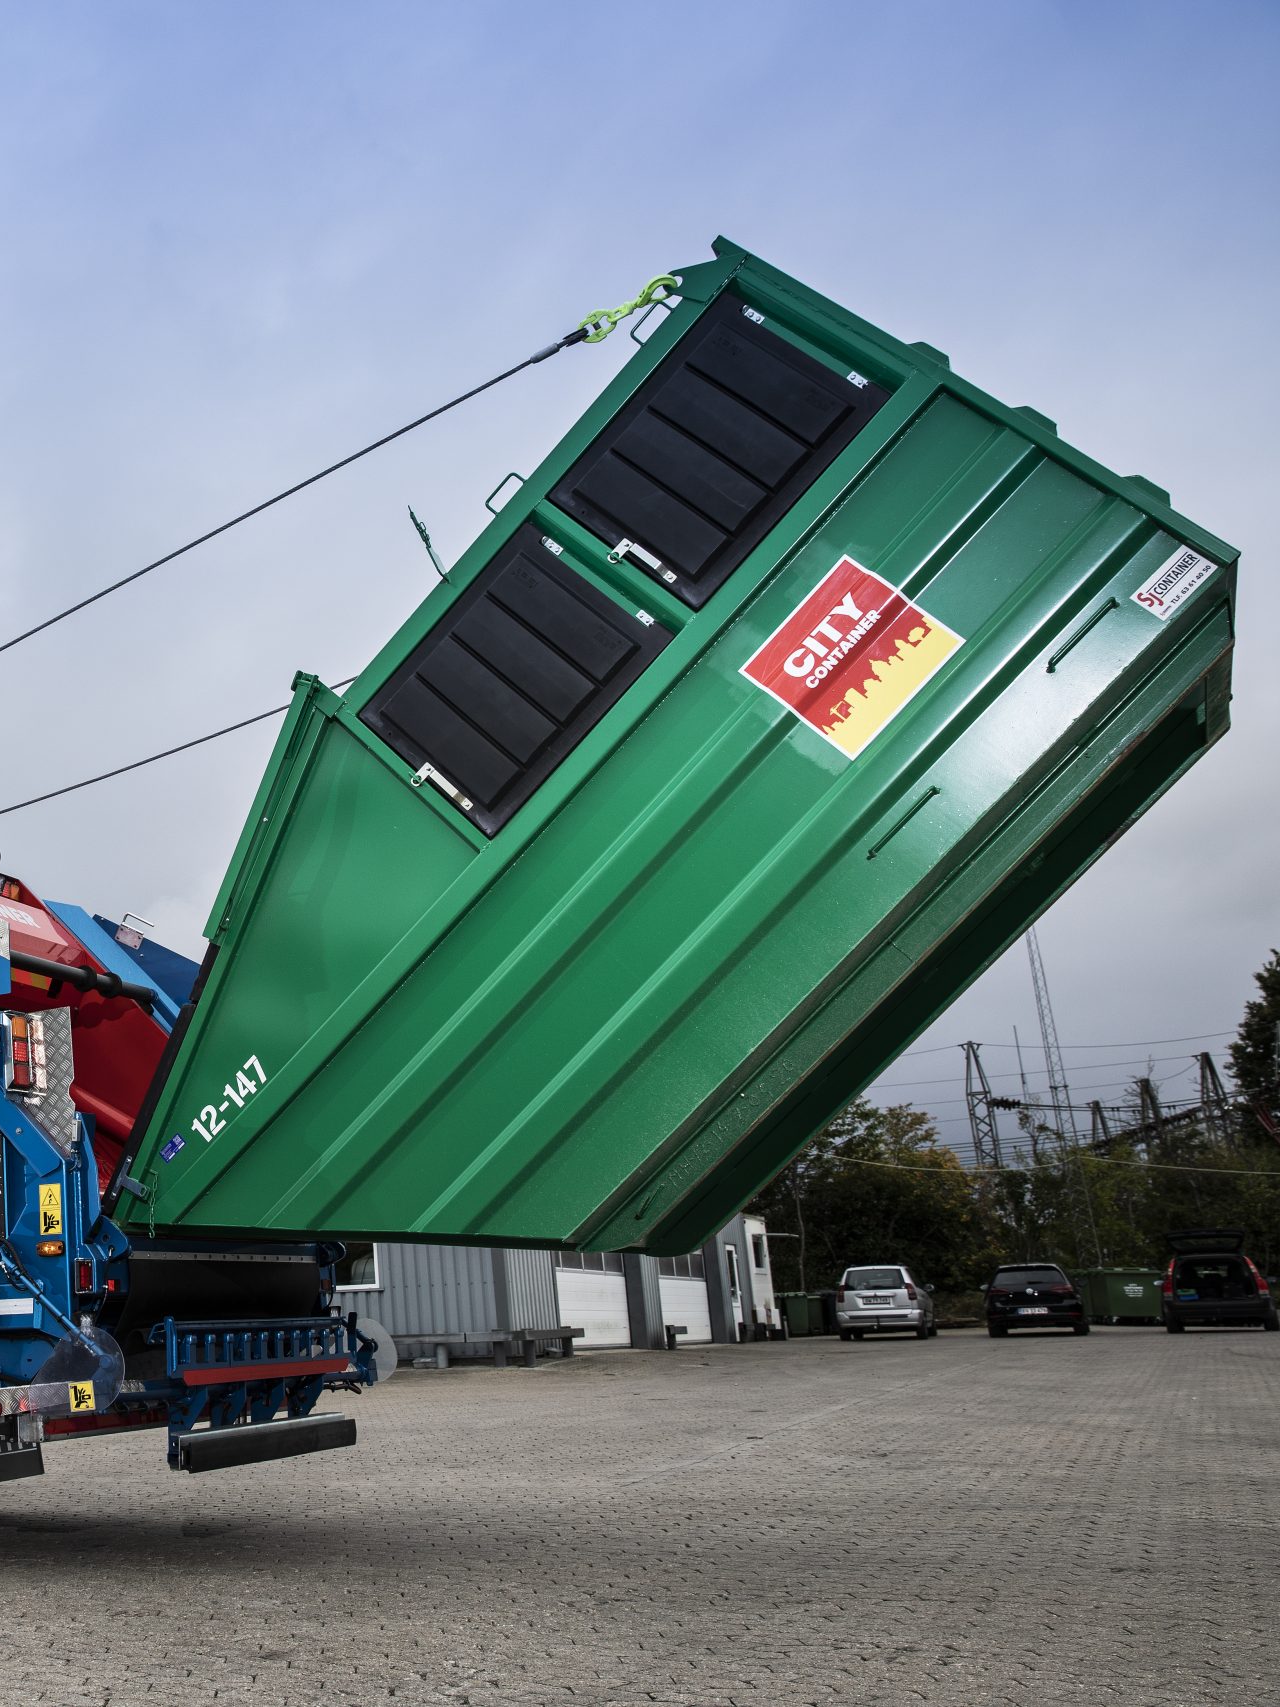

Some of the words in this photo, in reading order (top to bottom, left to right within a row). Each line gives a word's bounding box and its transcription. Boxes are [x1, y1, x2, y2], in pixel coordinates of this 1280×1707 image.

[1136, 592, 1164, 608] SJ
[1153, 553, 1198, 595] CONTAINER
[1181, 586, 1190, 595] 63
[783, 591, 863, 677] CITY
[805, 609, 882, 689] CONTAINER
[191, 1054, 267, 1143] 12-147
